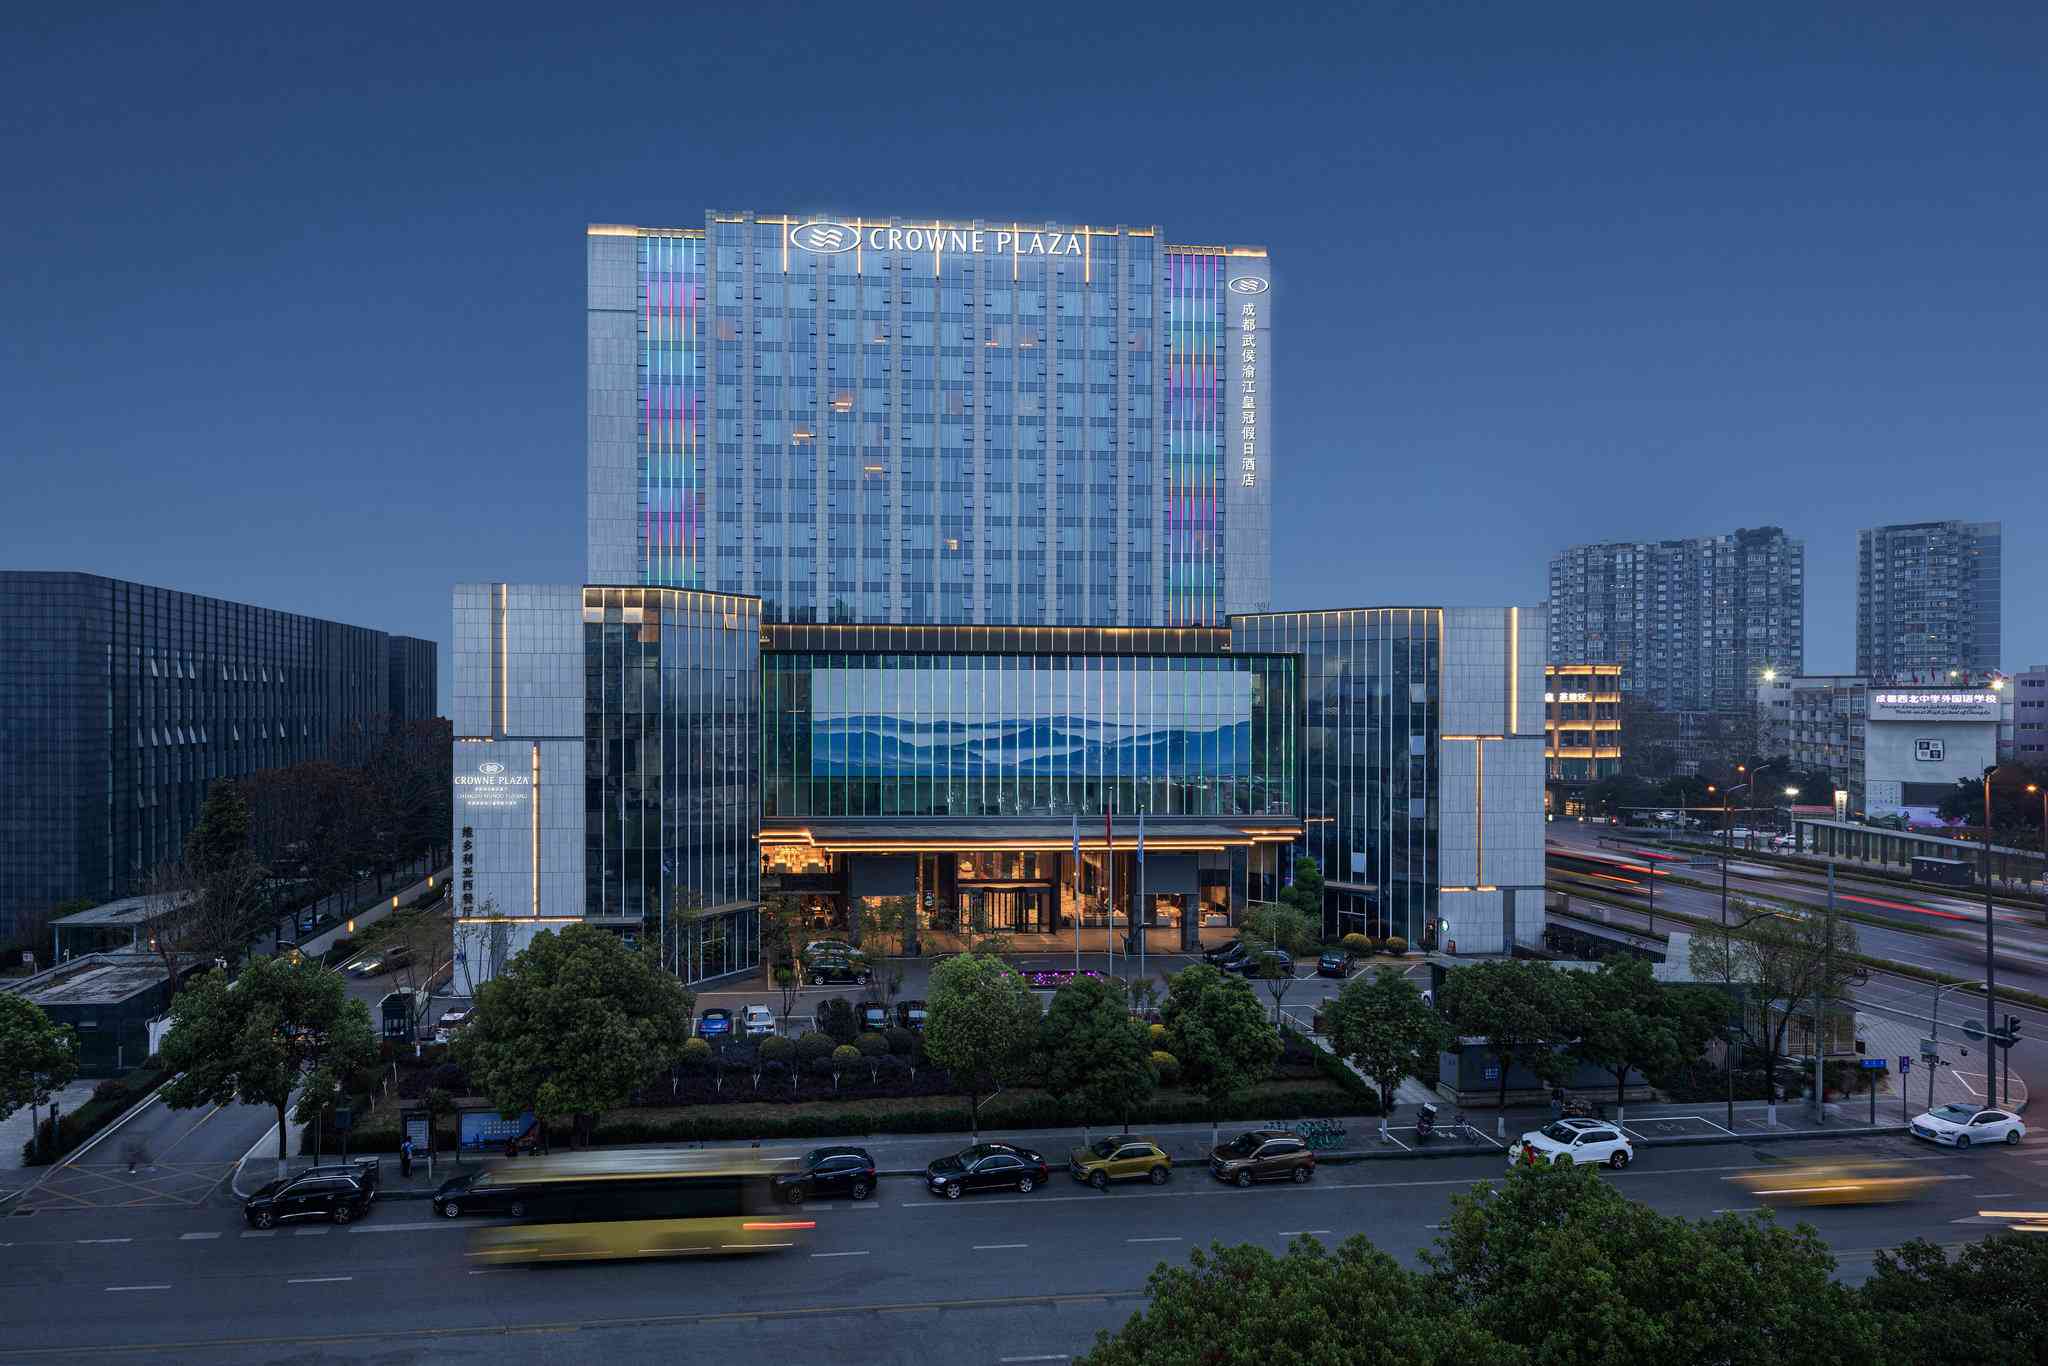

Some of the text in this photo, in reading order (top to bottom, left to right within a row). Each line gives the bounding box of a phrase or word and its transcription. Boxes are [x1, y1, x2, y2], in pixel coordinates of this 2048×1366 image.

[870, 228, 1082, 255] CROWNE PLAZA
[1242, 303, 1256, 487] 成都武侯渝江皇冠假日酒店
[454, 776, 529, 785] CROWNE PLAZA
